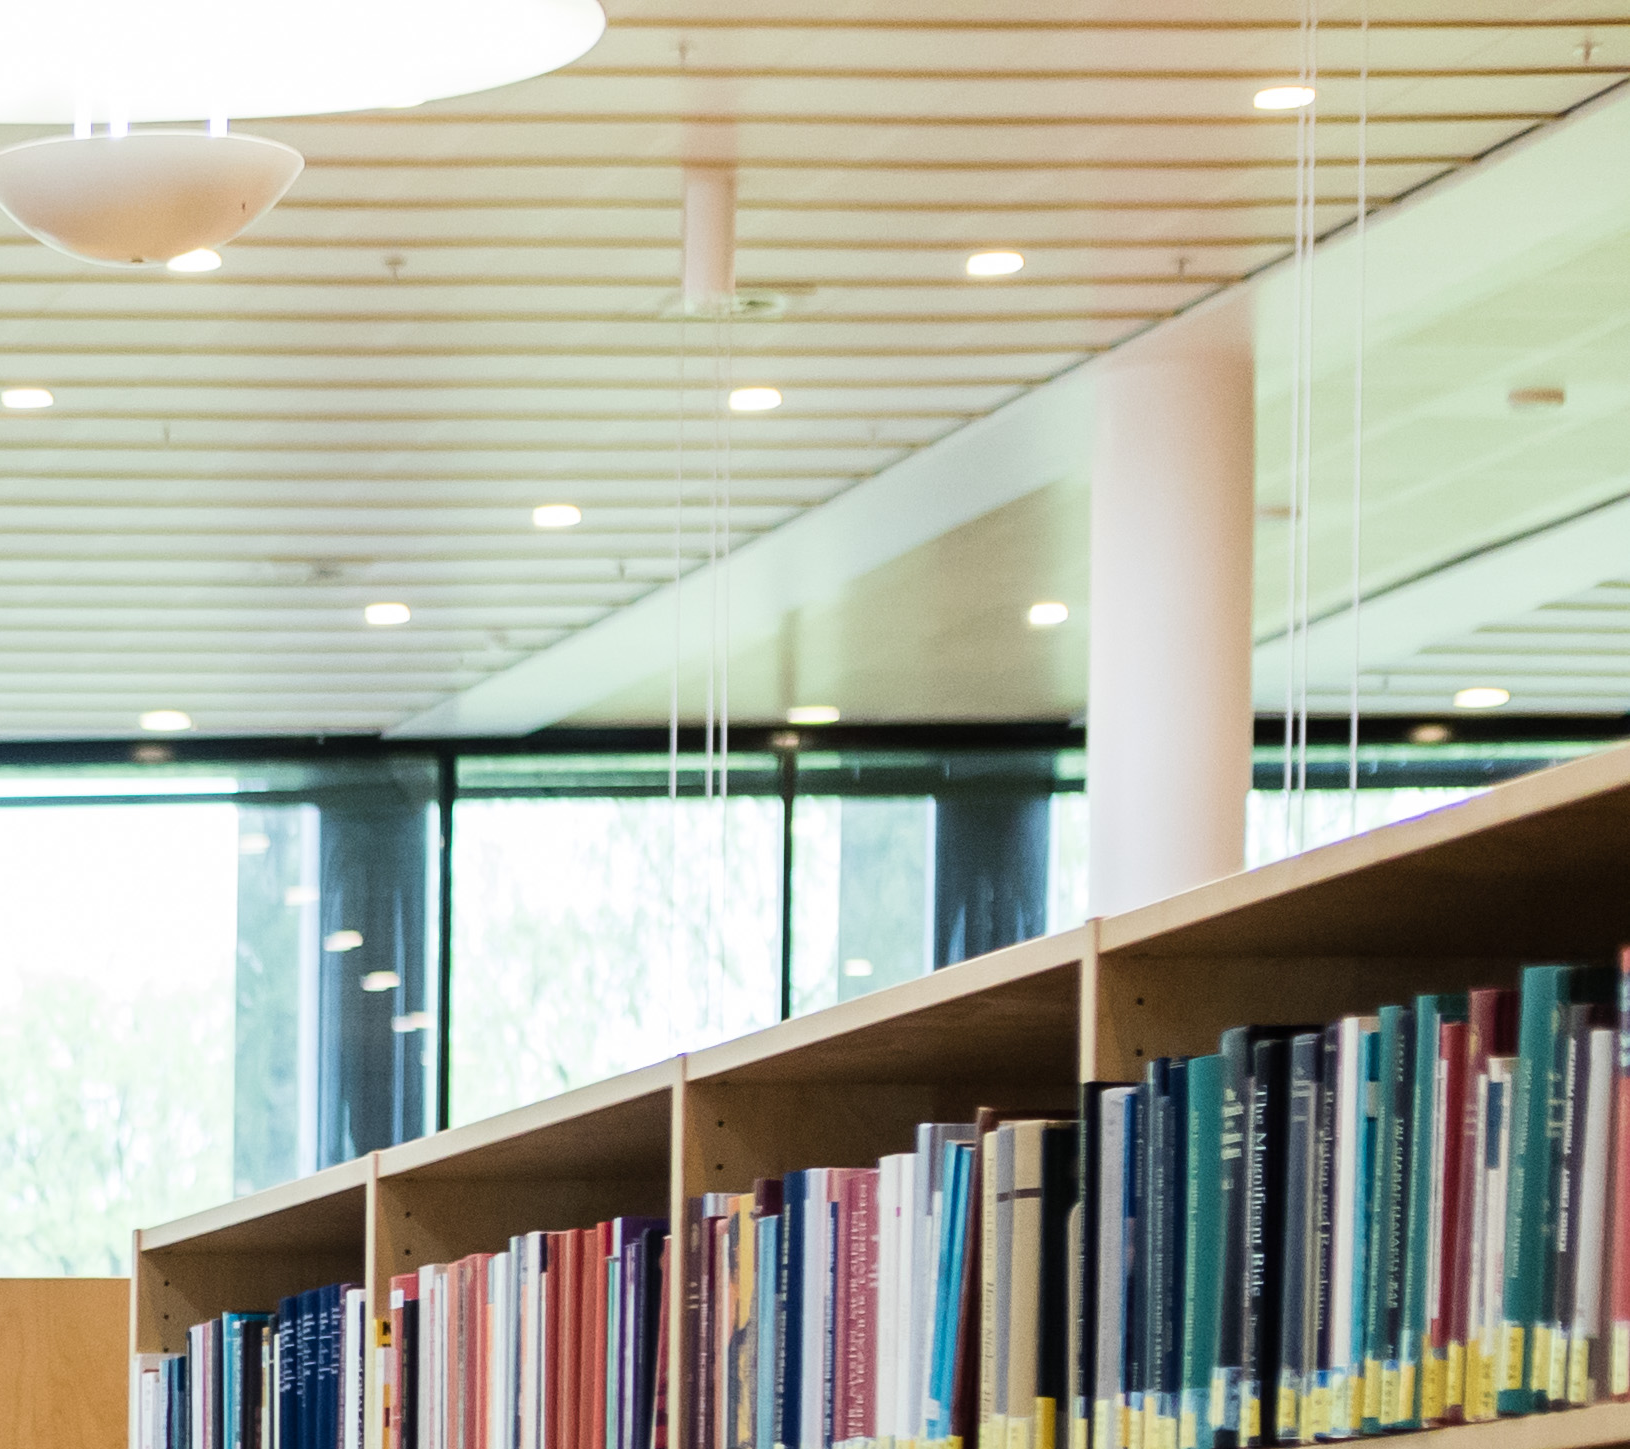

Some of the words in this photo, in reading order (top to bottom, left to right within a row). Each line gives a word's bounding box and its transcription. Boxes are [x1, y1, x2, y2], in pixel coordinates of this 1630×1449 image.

[1254, 1085, 1268, 1125] The
[1253, 1132, 1267, 1247] Magnificent
[1251, 1253, 1265, 1298] Ride
